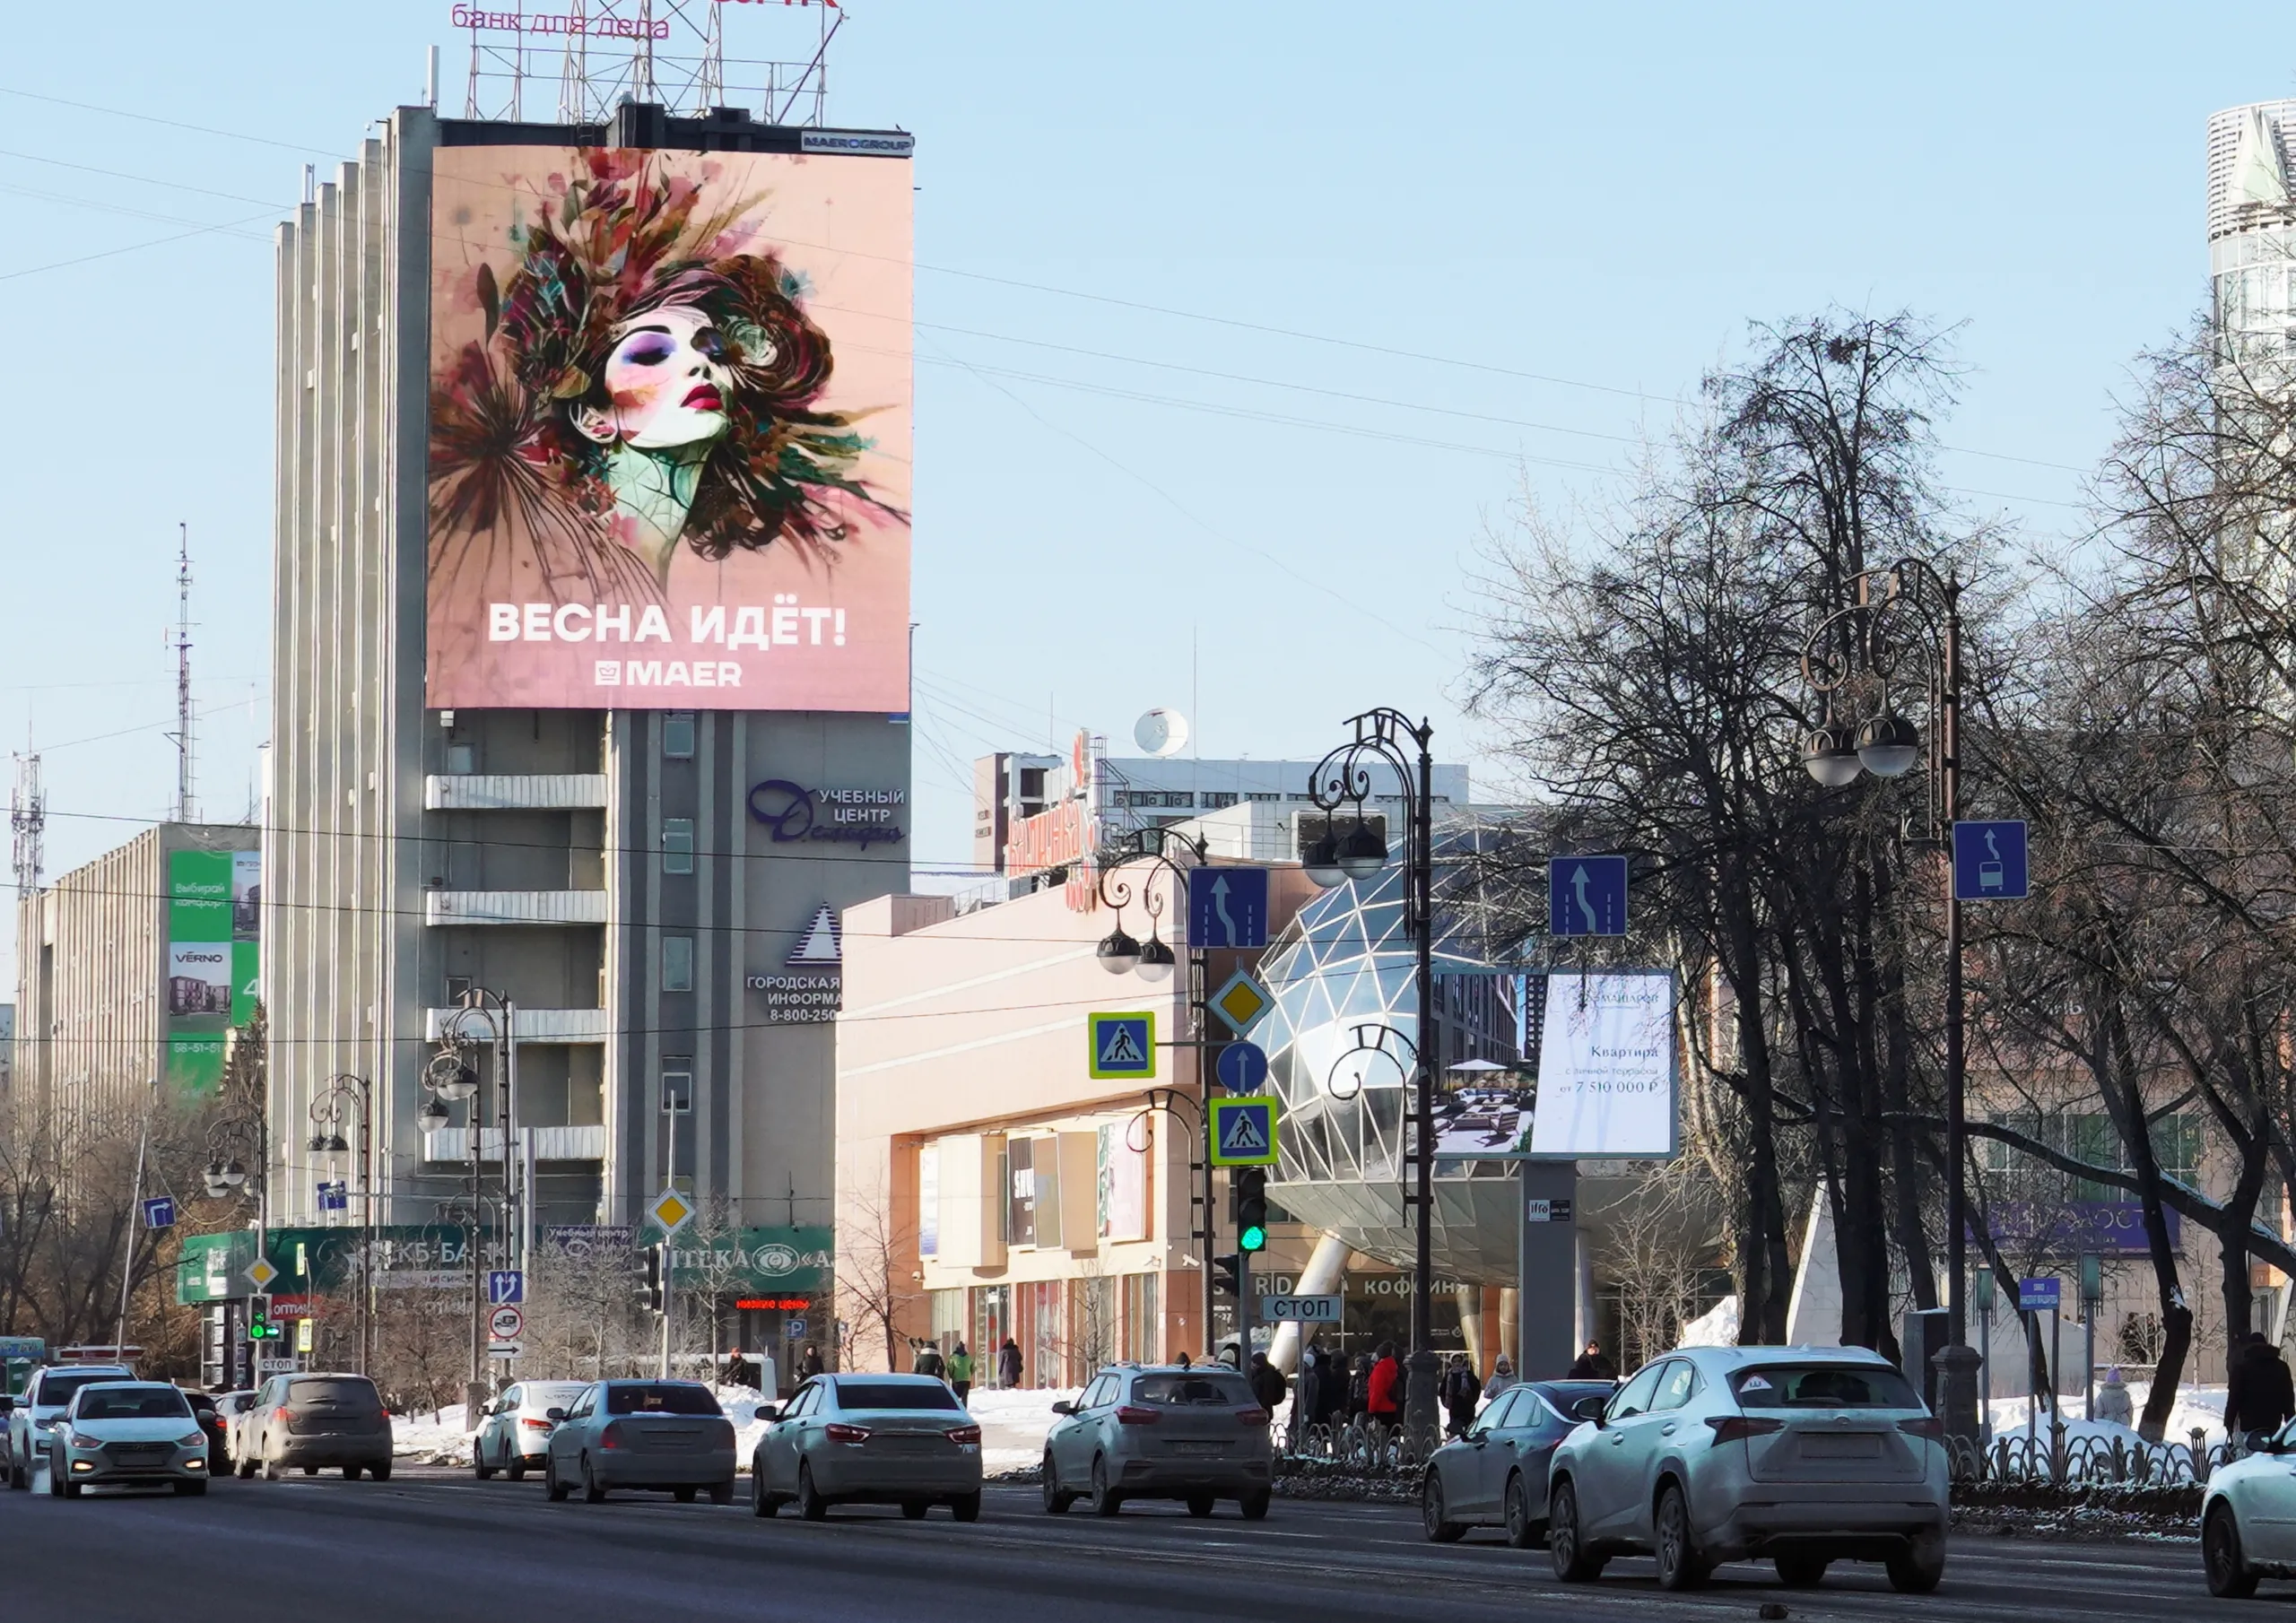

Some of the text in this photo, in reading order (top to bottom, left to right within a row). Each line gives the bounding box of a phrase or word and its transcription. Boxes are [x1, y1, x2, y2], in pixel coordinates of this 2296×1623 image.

[451, 4, 670, 39] банк для дела
[489, 593, 846, 651] ВЕСНА ИДЁТ!
[627, 660, 743, 688] MAER
[819, 788, 905, 805] УЧЕБНЫЙ
[834, 809, 891, 824] ЦЕНТР
[747, 976, 840, 990] ГОРОДСКАЯ
[1591, 1046, 1659, 1060] Квартира
[1576, 1081, 1584, 1093] 7
[1616, 1081, 1644, 1093] 000
[664, 1249, 750, 1269] ПТЕКА
[1273, 1300, 1330, 1317] СТОП
[263, 1359, 292, 1369] СТОП
